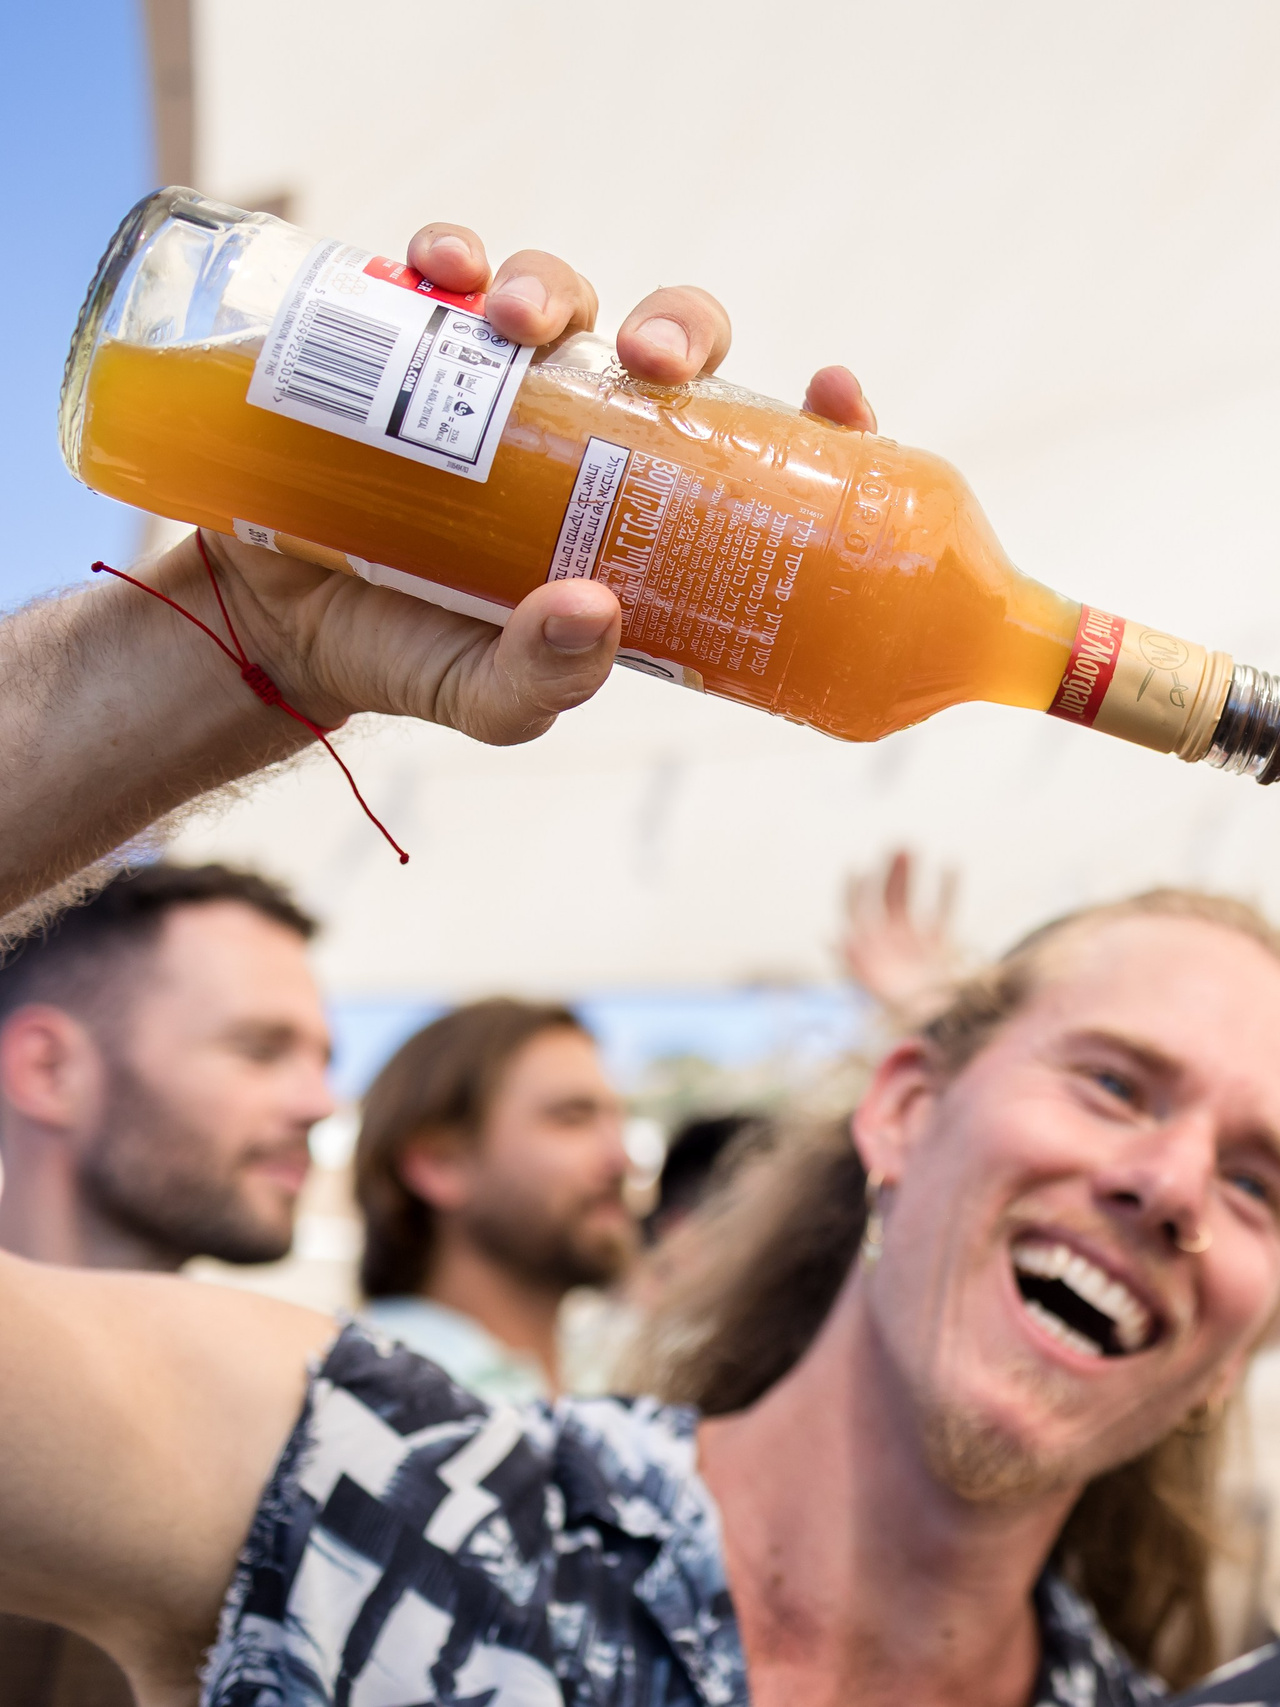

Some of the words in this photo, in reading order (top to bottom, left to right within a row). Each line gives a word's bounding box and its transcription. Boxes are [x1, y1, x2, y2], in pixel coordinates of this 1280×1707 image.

[289, 291, 307, 310] SOHO,
[275, 310, 297, 343] LONDON,
[264, 360, 278, 376] 7HS
[442, 395, 454, 413] ALCOHOL
[597, 455, 623, 499] אלכוהול
[648, 460, 677, 485] 30
[574, 464, 602, 510] לבריאות!
[591, 499, 609, 516] של
[618, 476, 671, 541] בפיקדון
[741, 497, 756, 522] חומרי
[750, 502, 772, 529] 35%
[565, 508, 585, 545] ומזיקה
[579, 515, 602, 554] מופרזת
[651, 546, 667, 572] משקה:
[659, 521, 675, 547] אנרגיה
[679, 473, 691, 488] 201
[766, 510, 793, 548] מתובל
[608, 537, 653, 574] חייב
[679, 542, 692, 564] IBBLS
[704, 533, 721, 553] קפטן
[740, 529, 761, 561] בנפח
[558, 546, 575, 568] חיים
[572, 555, 589, 580] ריכה
[660, 577, 671, 590] בני
[670, 541, 684, 556] טל:
[700, 553, 714, 572] עבור
[710, 556, 727, 583] מאכל:
[725, 546, 740, 571] סירופ
[758, 549, 776, 571] רום
[669, 564, 687, 597] בישראל:
[732, 562, 754, 586] כהל
[748, 571, 769, 600] בסיס
[620, 575, 641, 606] פרווה
[704, 583, 717, 601] צבע
[758, 610, 783, 645] מורגן
[773, 550, 803, 602] ספייסד
[660, 599, 675, 622] הרשמי
[708, 607, 720, 623] מים
[743, 602, 764, 617] על
[655, 622, 668, 643] היבואן
[704, 622, 715, 638] רום,
[716, 614, 735, 635] 750
[708, 634, 731, 665] תכולה:
[726, 645, 746, 670] משקה
[1054, 630, 1116, 716] Morgan
